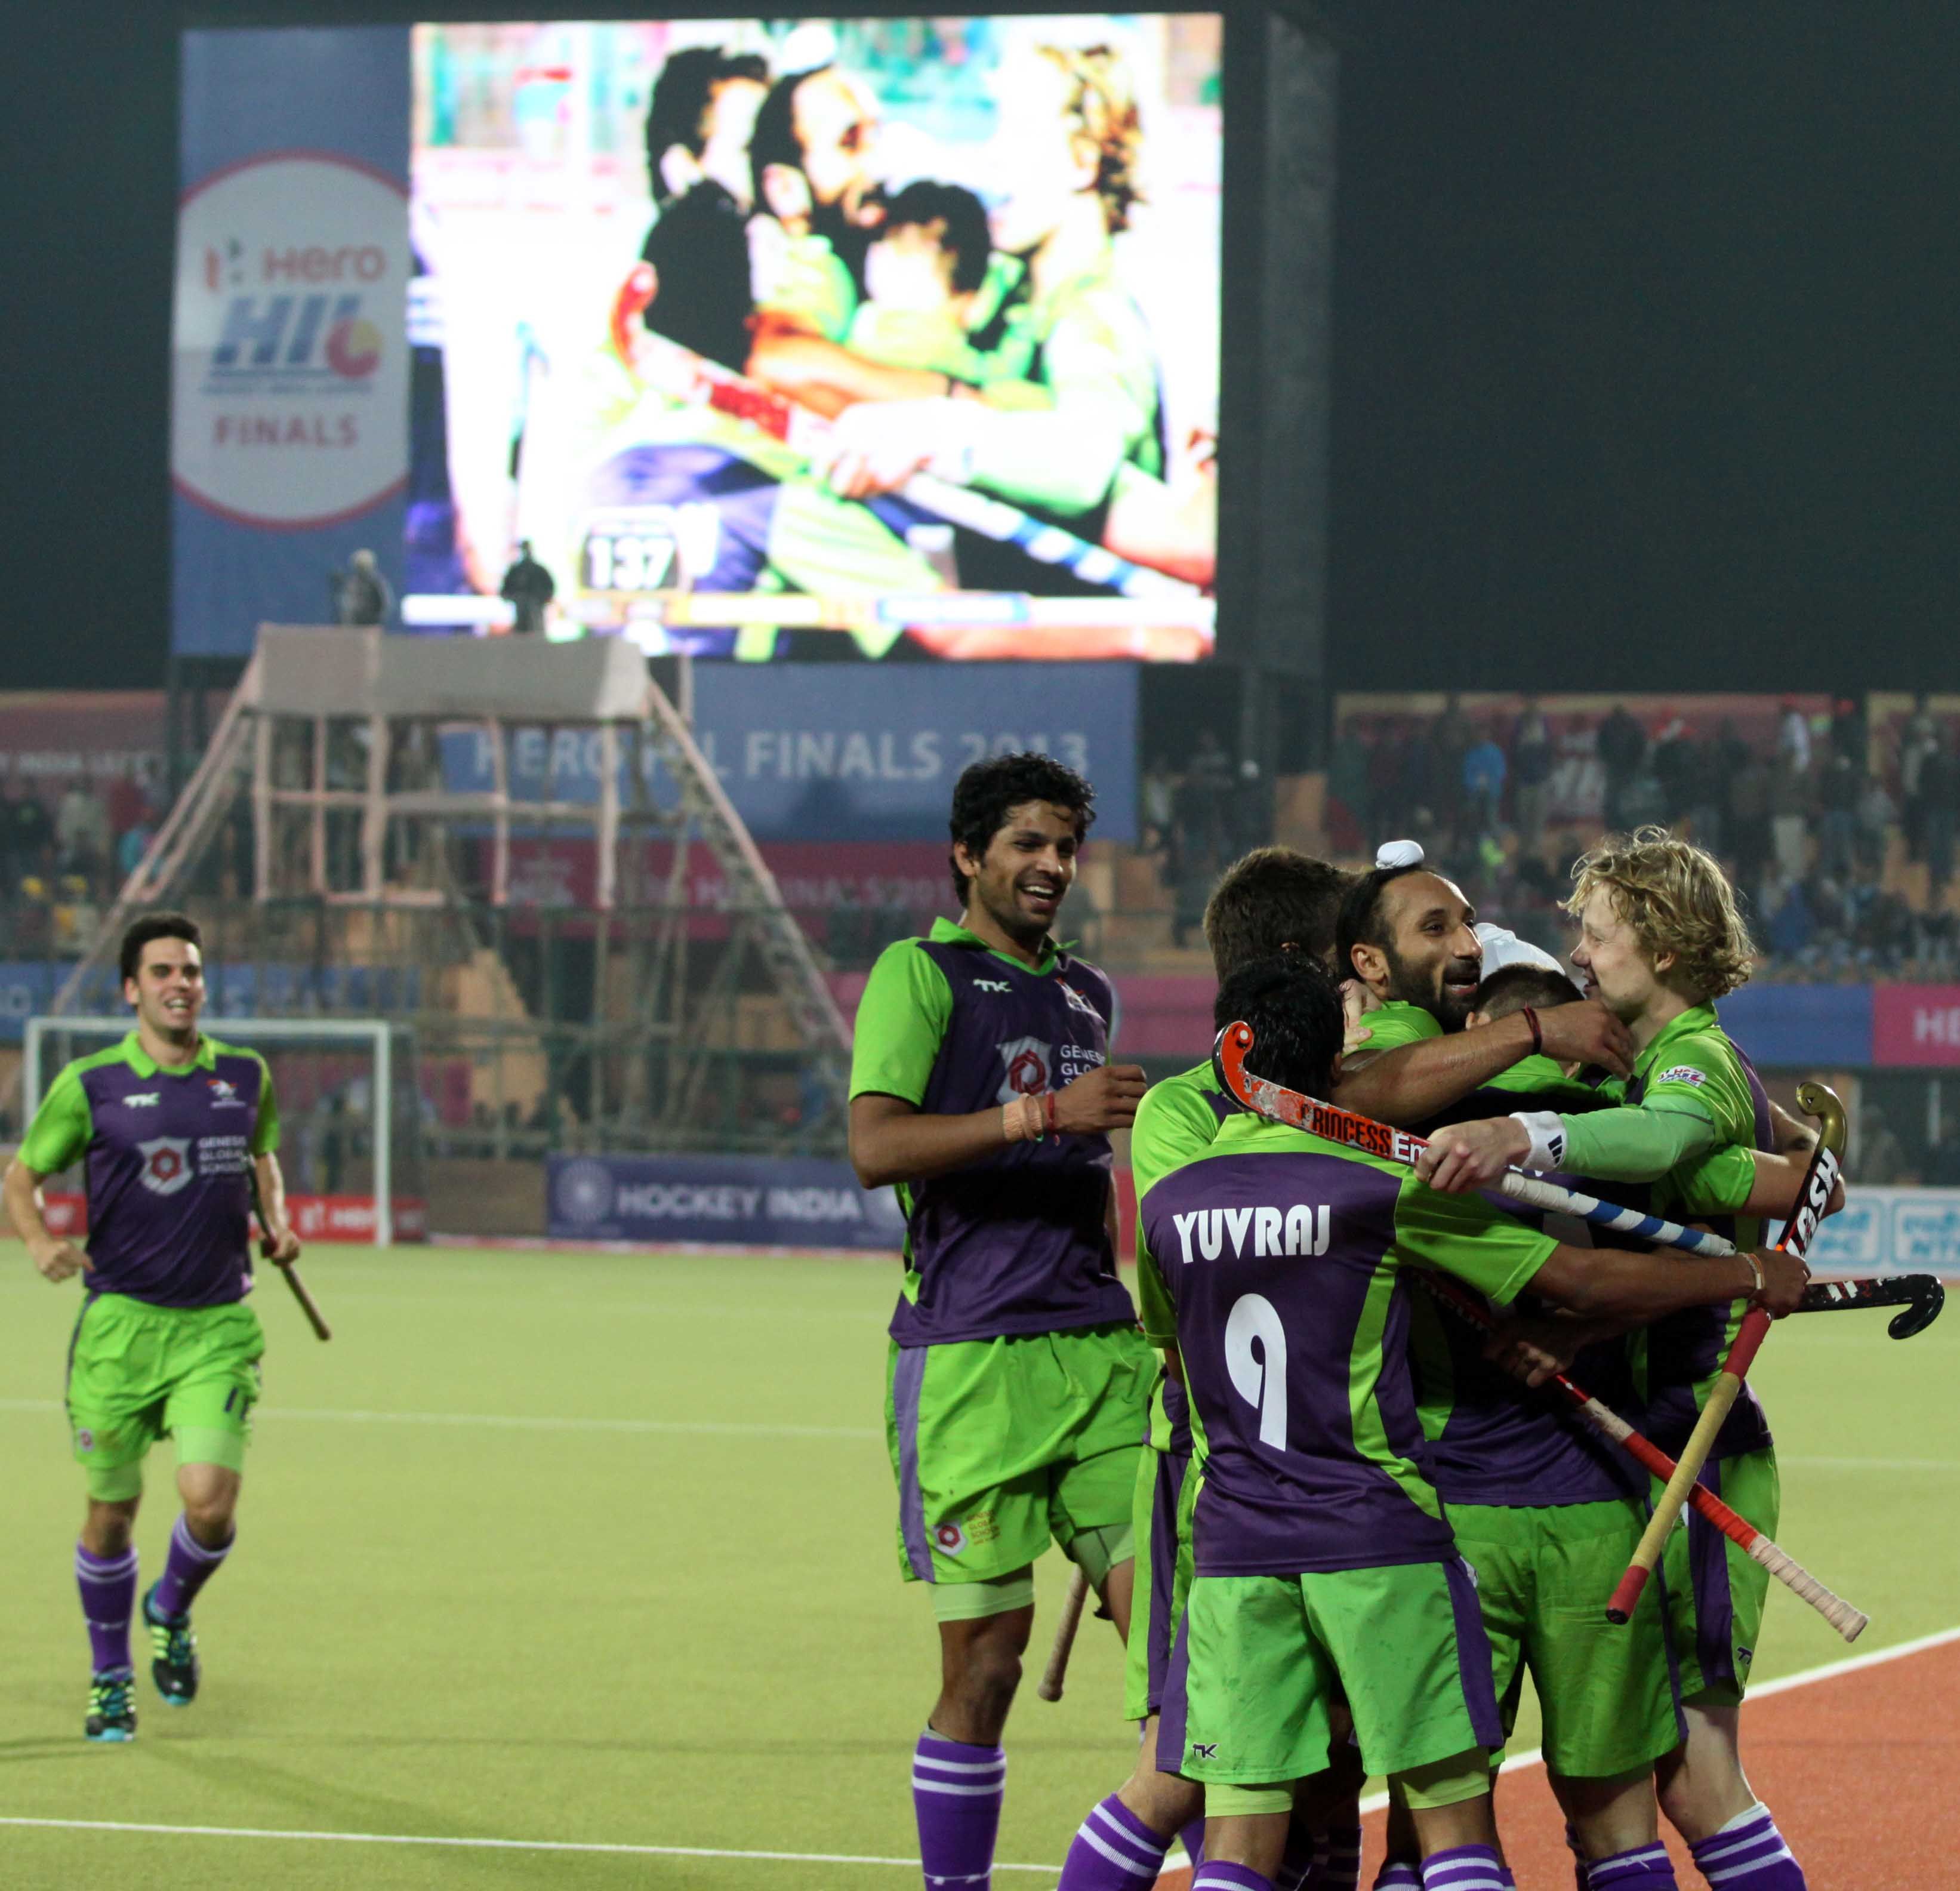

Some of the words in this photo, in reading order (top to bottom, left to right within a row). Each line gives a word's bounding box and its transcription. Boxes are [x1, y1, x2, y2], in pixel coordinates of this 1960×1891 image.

[261, 245, 387, 283] Hero
[213, 415, 360, 451] FINALS
[746, 729, 942, 780] FINALS
[617, 1184, 759, 1219] HOCKEY
[767, 1187, 861, 1222] INDIA
[1173, 1205, 1330, 1263] YUVRAJ
[1225, 1293, 1287, 1452] 9
[1192, 1743, 1218, 1758] TK
